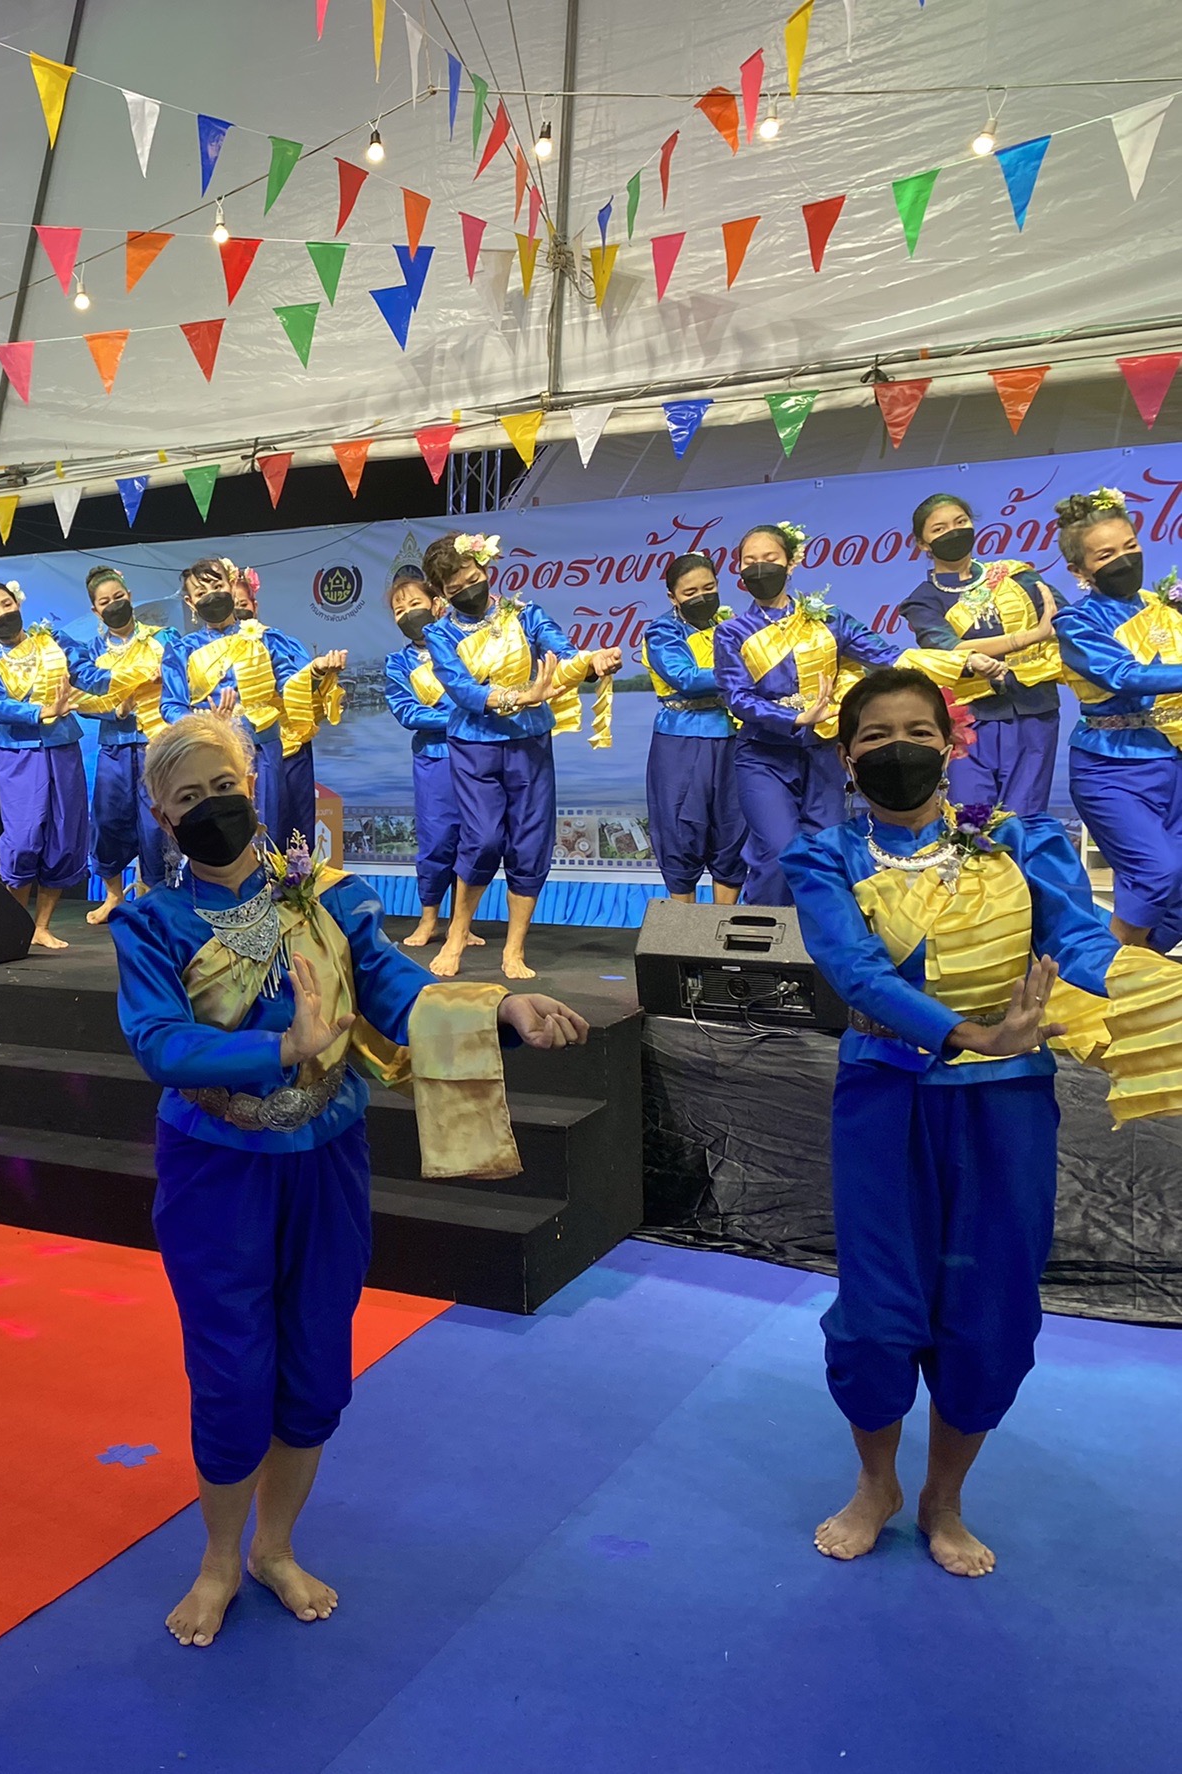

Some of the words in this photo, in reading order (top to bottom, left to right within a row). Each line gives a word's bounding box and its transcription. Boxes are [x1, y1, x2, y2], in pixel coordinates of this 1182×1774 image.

[309, 599, 366, 622] กรมการพัฒนาชุมชน
